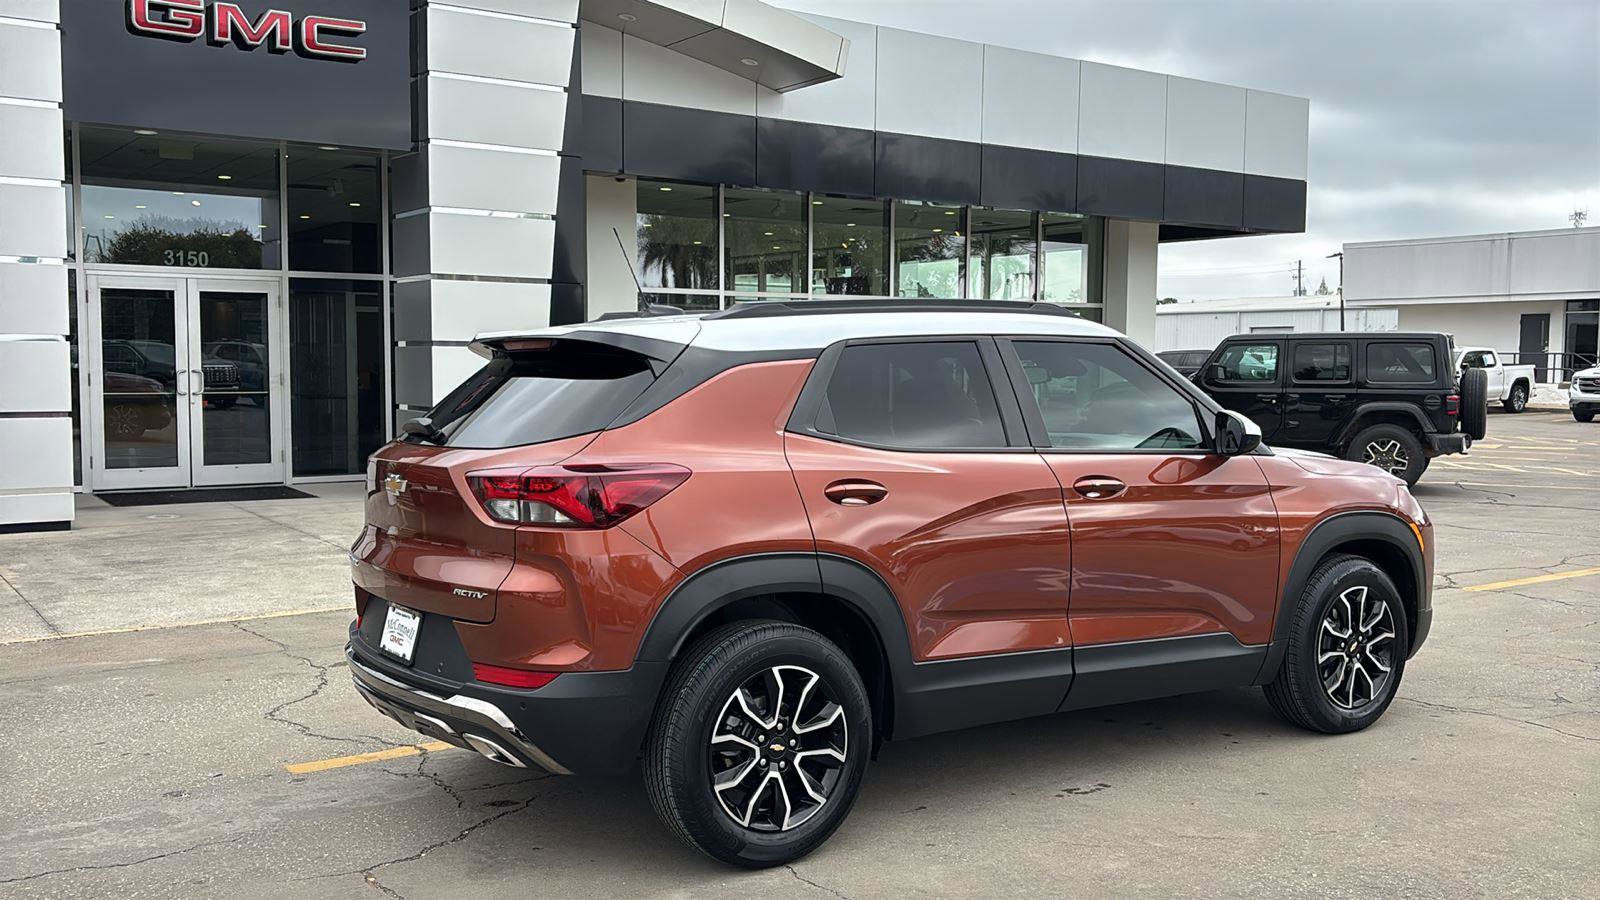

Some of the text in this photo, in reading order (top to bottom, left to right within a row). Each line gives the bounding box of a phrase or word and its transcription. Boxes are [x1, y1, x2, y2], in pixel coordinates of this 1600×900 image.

[130, 0, 367, 60] GMC
[164, 250, 209, 267] 3150
[453, 588, 488, 599] ACTIV
[390, 634, 404, 646] GMC
